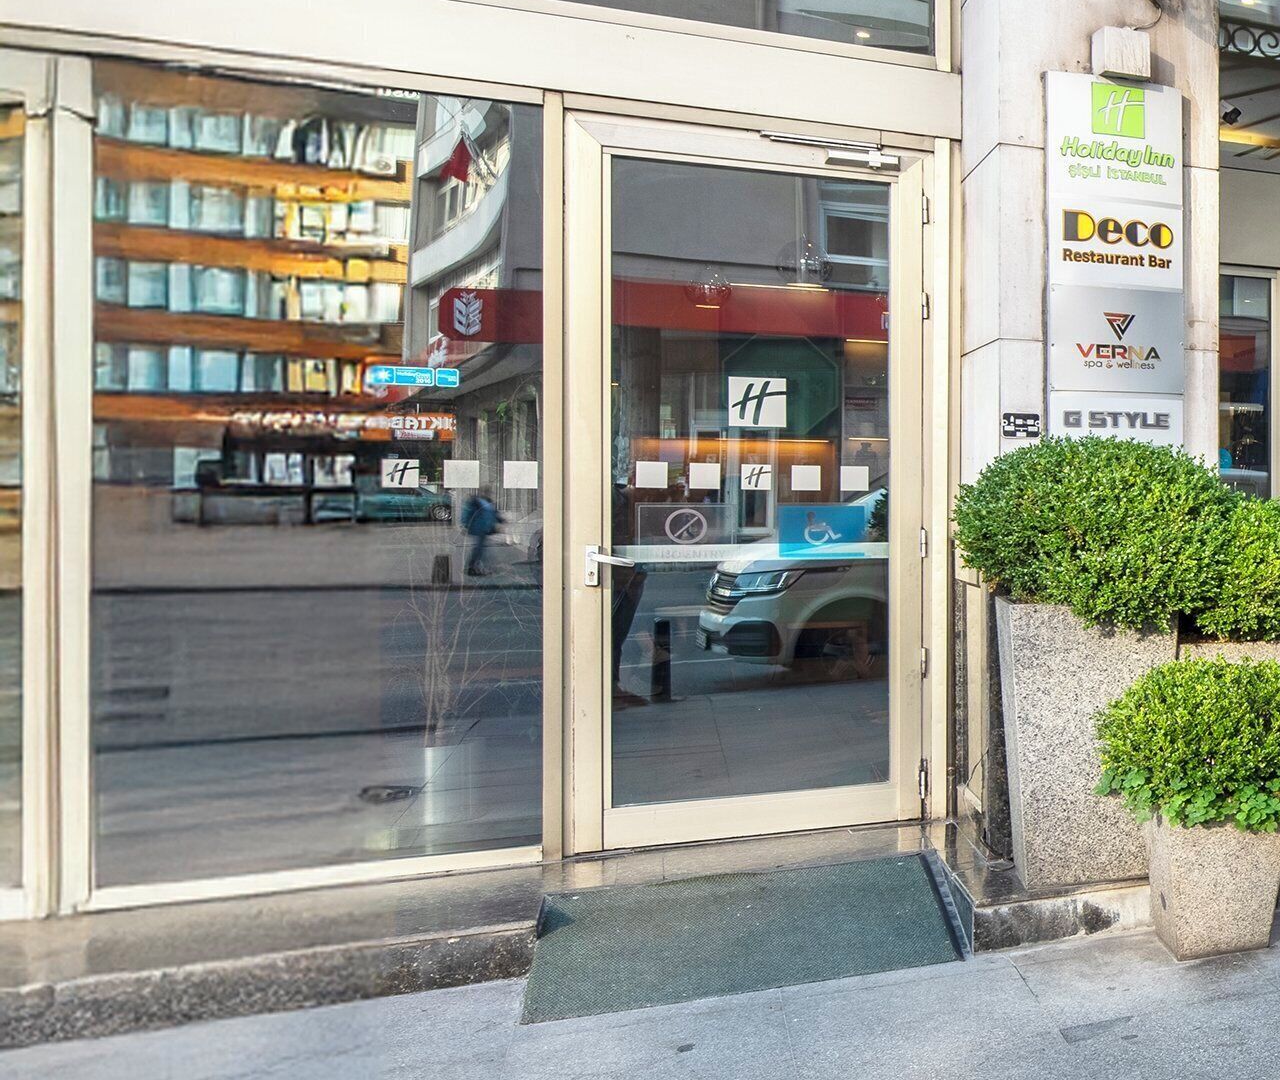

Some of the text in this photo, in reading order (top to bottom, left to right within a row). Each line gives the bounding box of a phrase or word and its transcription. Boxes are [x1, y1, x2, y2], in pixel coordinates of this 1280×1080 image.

[1060, 135, 1175, 169] Holiday Inn
[1062, 208, 1174, 250] Deco
[1062, 248, 1172, 270] Restaurant Bar
[1075, 343, 1161, 361] VERNA
[1083, 360, 1103, 369] spa
[1117, 360, 1155, 370] wellness
[1063, 410, 1170, 430] G STYLE
